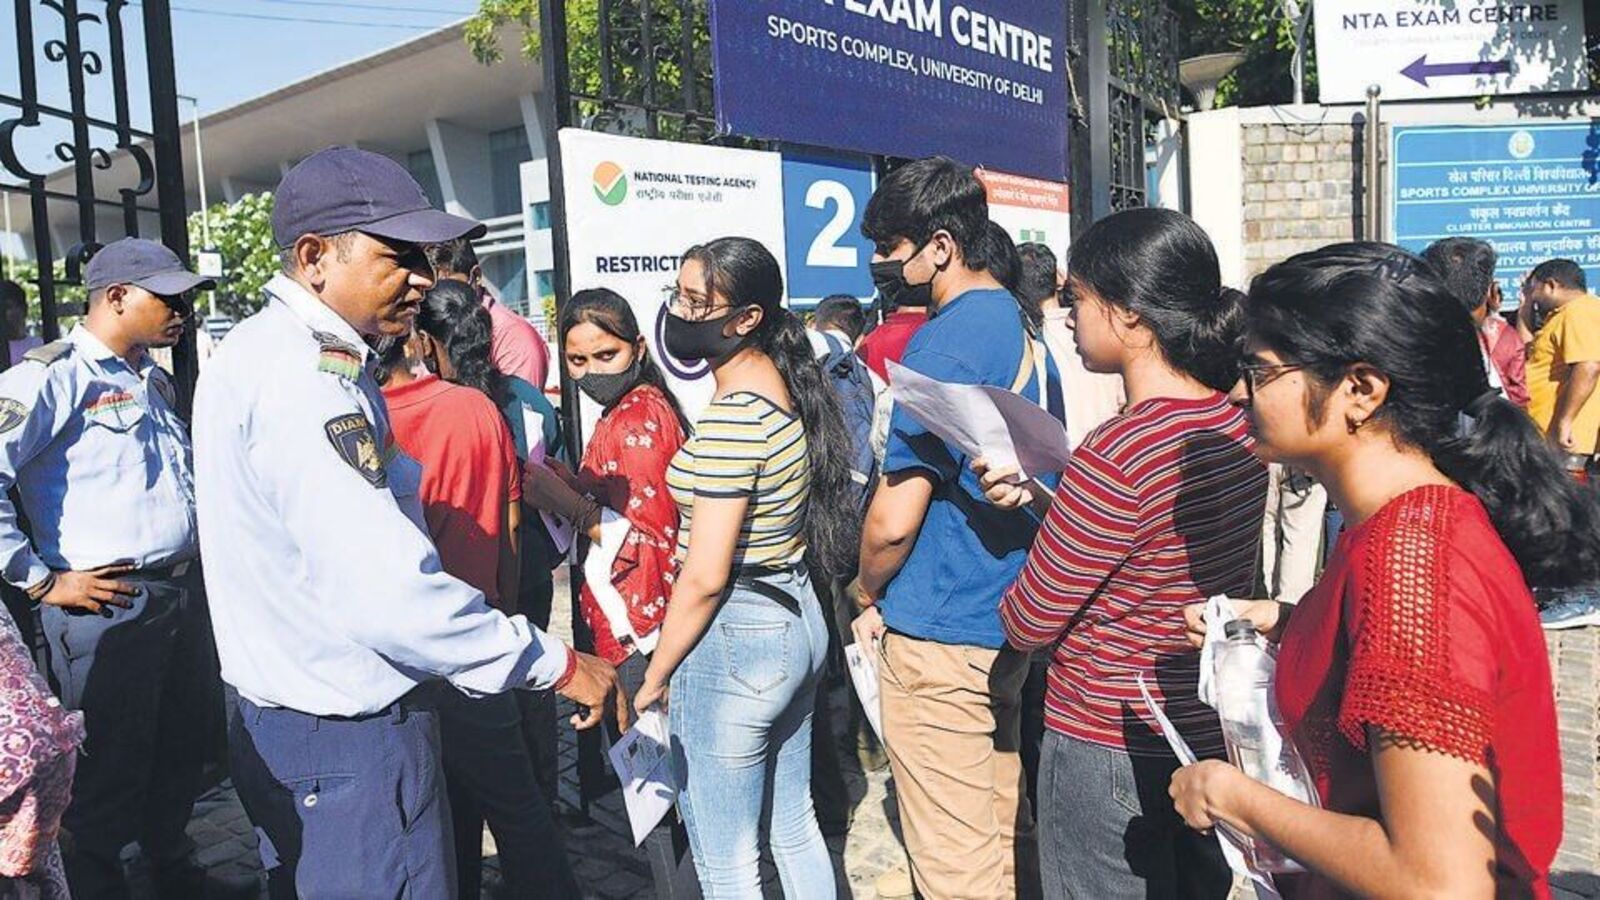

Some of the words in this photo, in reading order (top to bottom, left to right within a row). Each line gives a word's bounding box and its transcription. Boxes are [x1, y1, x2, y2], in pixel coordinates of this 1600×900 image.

[1342, 12, 1388, 30] NTA
[1396, 10, 1461, 27] EXAM
[1469, 4, 1559, 23] CENTRE
[844, 0, 942, 38] XAM
[950, 6, 1053, 73] CENTRE
[767, 15, 838, 52] SPORTS
[841, 35, 919, 75] COMPLEX,
[921, 57, 993, 91] UNIVERSITY
[994, 78, 1011, 95] OF
[1013, 83, 1043, 104] DELHI
[634, 171, 682, 184] NATIONAL
[684, 174, 721, 187] TESTING
[723, 177, 756, 189] AGENCY
[1400, 186, 1449, 199] SPORTS
[1451, 185, 1510, 197] COMPLEX
[1512, 183, 1582, 195] UNIVERSITY
[805, 179, 858, 268] 2
[1446, 221, 1492, 232] CLUSTER
[1493, 219, 1551, 230] INNOVATION
[1553, 218, 1592, 228] CENTRE
[596, 256, 683, 274] RESTRICT
